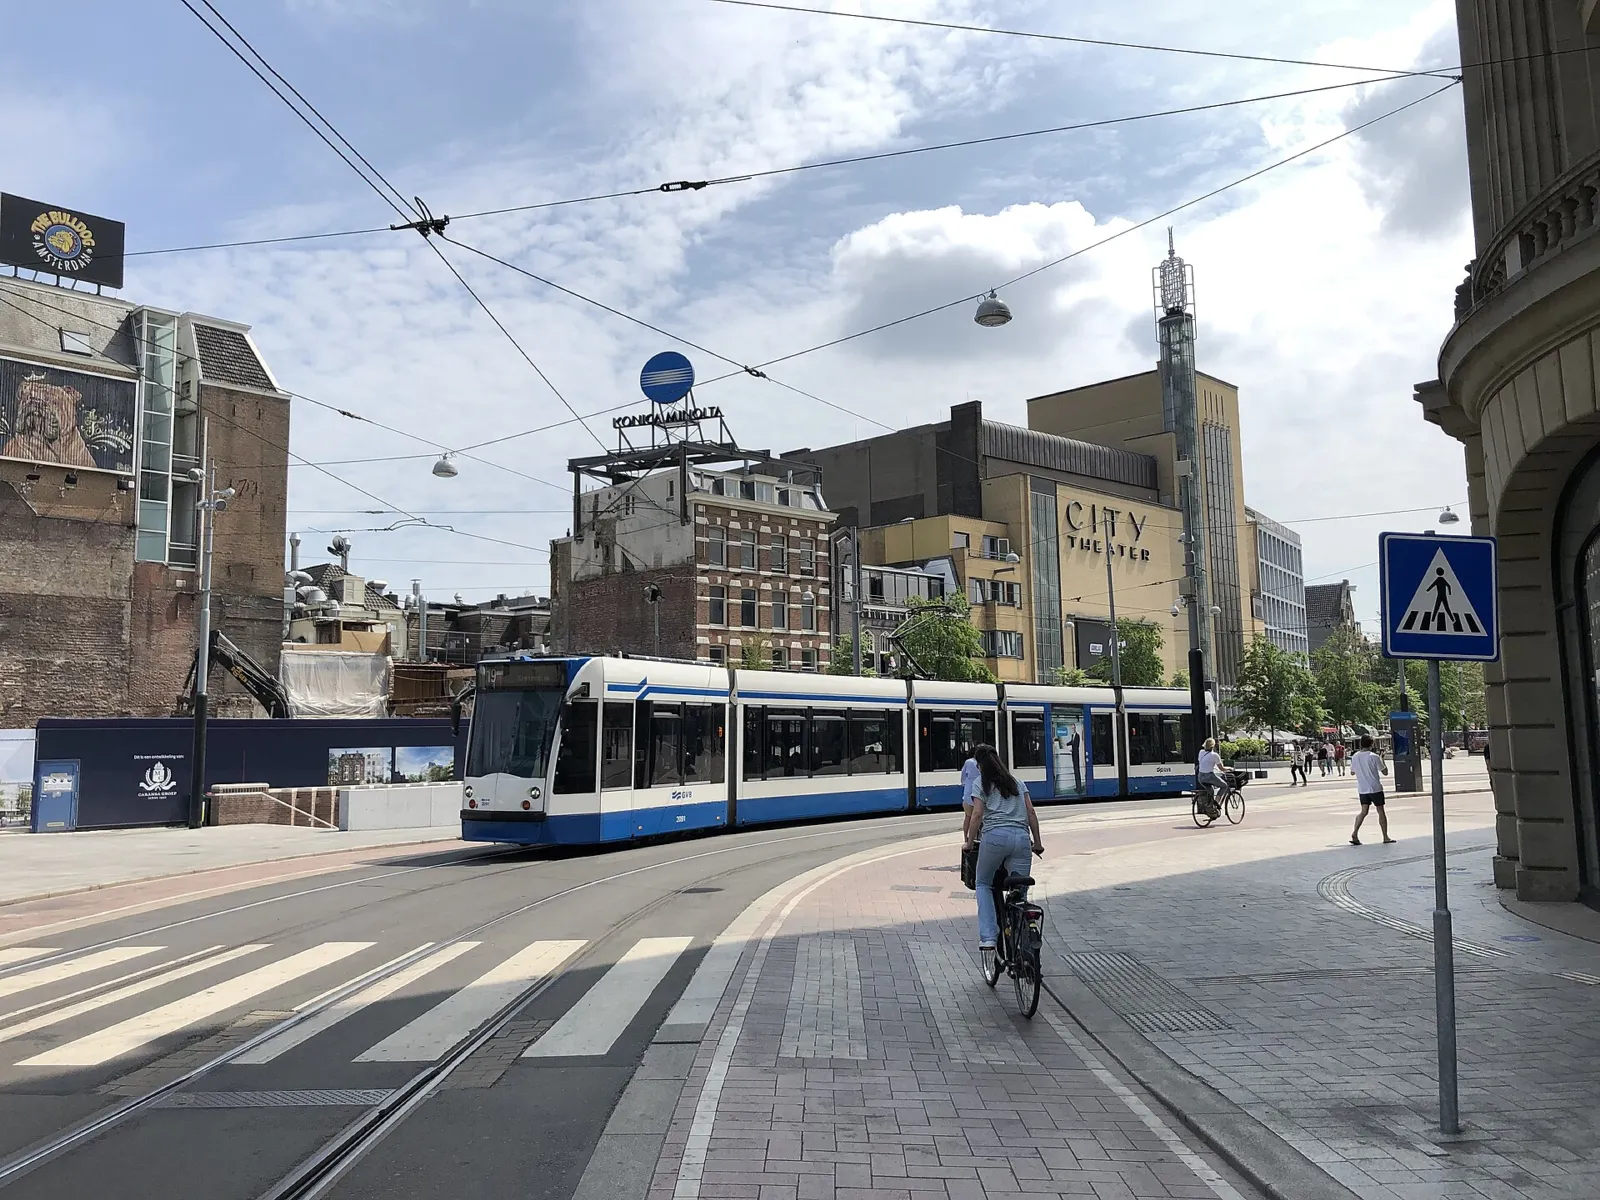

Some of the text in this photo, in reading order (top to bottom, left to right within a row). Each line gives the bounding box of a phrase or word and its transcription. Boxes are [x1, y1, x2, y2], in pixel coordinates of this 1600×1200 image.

[31, 211, 95, 247] THE BULLDOG
[32, 242, 93, 271] AMSTERDAM
[612, 406, 725, 429] KONICA MINOLTA
[1066, 500, 1146, 542] CITY
[1067, 535, 1150, 561] THEATER
[486, 668, 497, 683] 19
[681, 791, 693, 799] GVB
